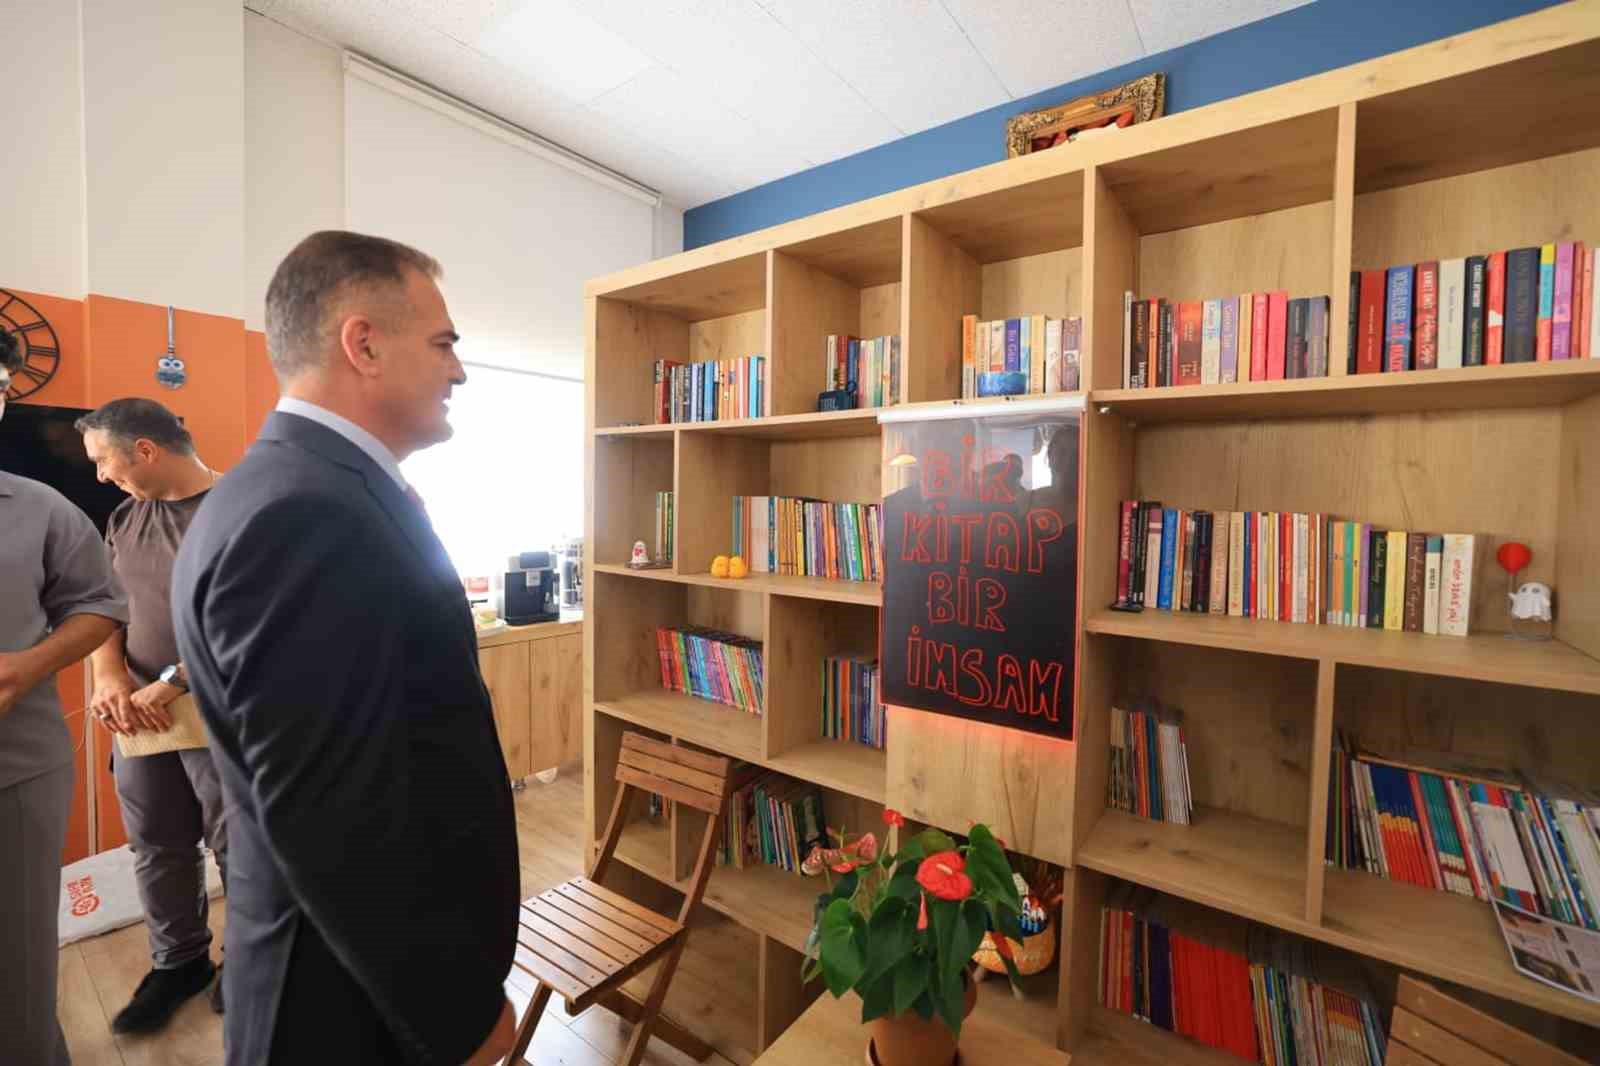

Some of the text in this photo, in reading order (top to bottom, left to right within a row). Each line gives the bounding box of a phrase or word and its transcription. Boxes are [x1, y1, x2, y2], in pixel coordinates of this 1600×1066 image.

[923, 434, 1014, 503] BİR
[901, 502, 1064, 574] KİTAP
[928, 566, 1008, 632] BİR
[907, 625, 1064, 723] İNSAN
